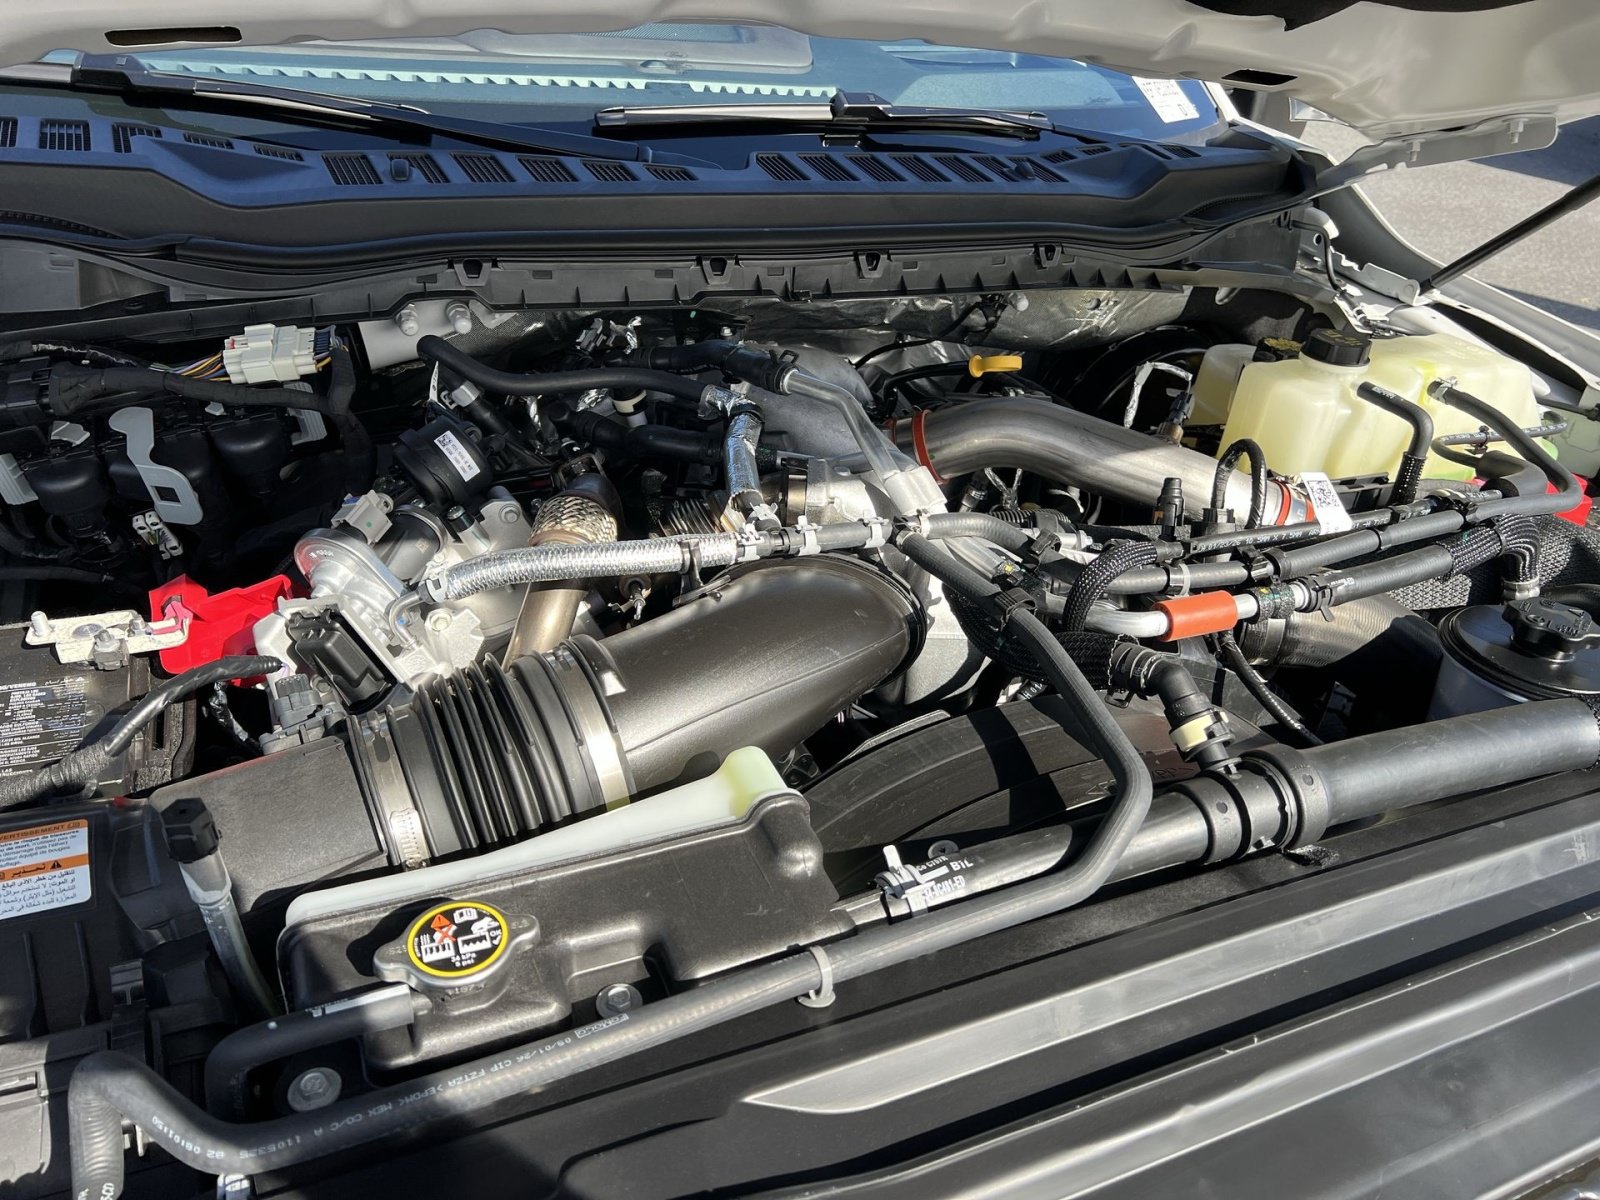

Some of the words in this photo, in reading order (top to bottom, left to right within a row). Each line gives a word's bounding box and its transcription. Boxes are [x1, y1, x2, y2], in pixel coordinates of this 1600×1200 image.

[489, 929, 502, 938] OK
[451, 956, 461, 965] 34
[460, 952, 477, 962] kPa
[462, 957, 475, 967] psi
[490, 1059, 512, 1073] CIP
[367, 1101, 393, 1118] MEX
